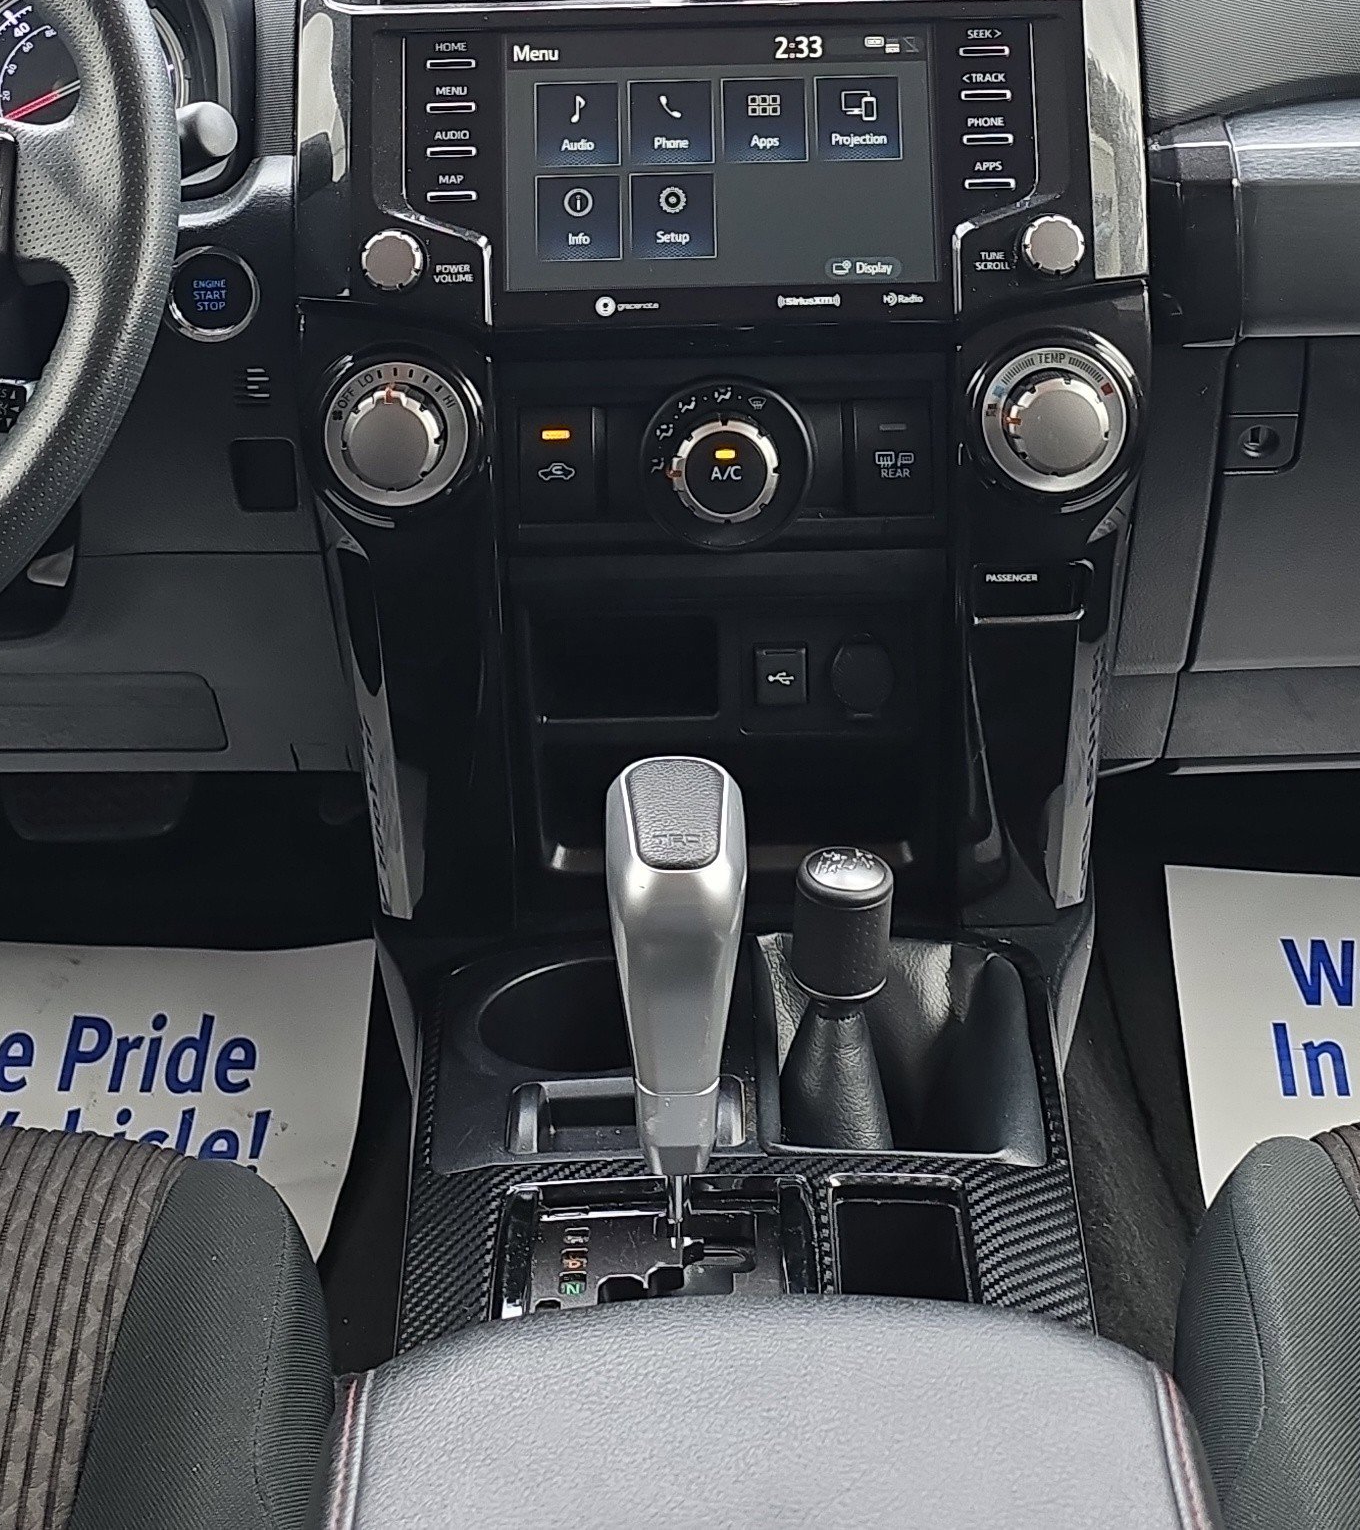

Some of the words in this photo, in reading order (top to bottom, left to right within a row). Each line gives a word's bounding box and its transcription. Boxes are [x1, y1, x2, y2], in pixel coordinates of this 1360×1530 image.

[13, 22, 30, 38] 40
[22, 41, 34, 53] 60
[435, 42, 467, 52] HOME
[774, 35, 823, 59] 2:33
[513, 45, 559, 62] Menu
[7, 64, 17, 75] 40
[2, 90, 10, 101] 20
[435, 86, 468, 96] MENU
[967, 116, 1004, 127] PHONE
[434, 130, 469, 140] AUDIO
[831, 132, 887, 147] Projection
[561, 138, 595, 151] Audio
[653, 137, 689, 150] Phone
[750, 134, 780, 149] Apps
[974, 161, 1003, 171] APPS
[438, 175, 464, 185] MAP
[568, 232, 591, 246] Info
[656, 231, 690, 246] Setup
[980, 251, 1005, 260] TUNE
[436, 264, 471, 273] POWER
[856, 262, 893, 275] Display
[975, 261, 1010, 271] SCROLL
[193, 279, 226, 288] ENGINE
[434, 273, 474, 283] VOLUME
[193, 290, 227, 300] START
[898, 294, 924, 304] Radio
[196, 301, 226, 311] STOP
[1037, 353, 1066, 365] TEMP
[358, 374, 374, 388] LO
[337, 387, 355, 410] OFF
[443, 395, 456, 408] HI
[710, 466, 742, 481] A/C
[881, 469, 910, 478] REAR
[985, 573, 1038, 583] PASSENGER
[57, 1012, 258, 1094] Pride
[1271, 1021, 1351, 1099] In
[566, 1283, 580, 1295] N
